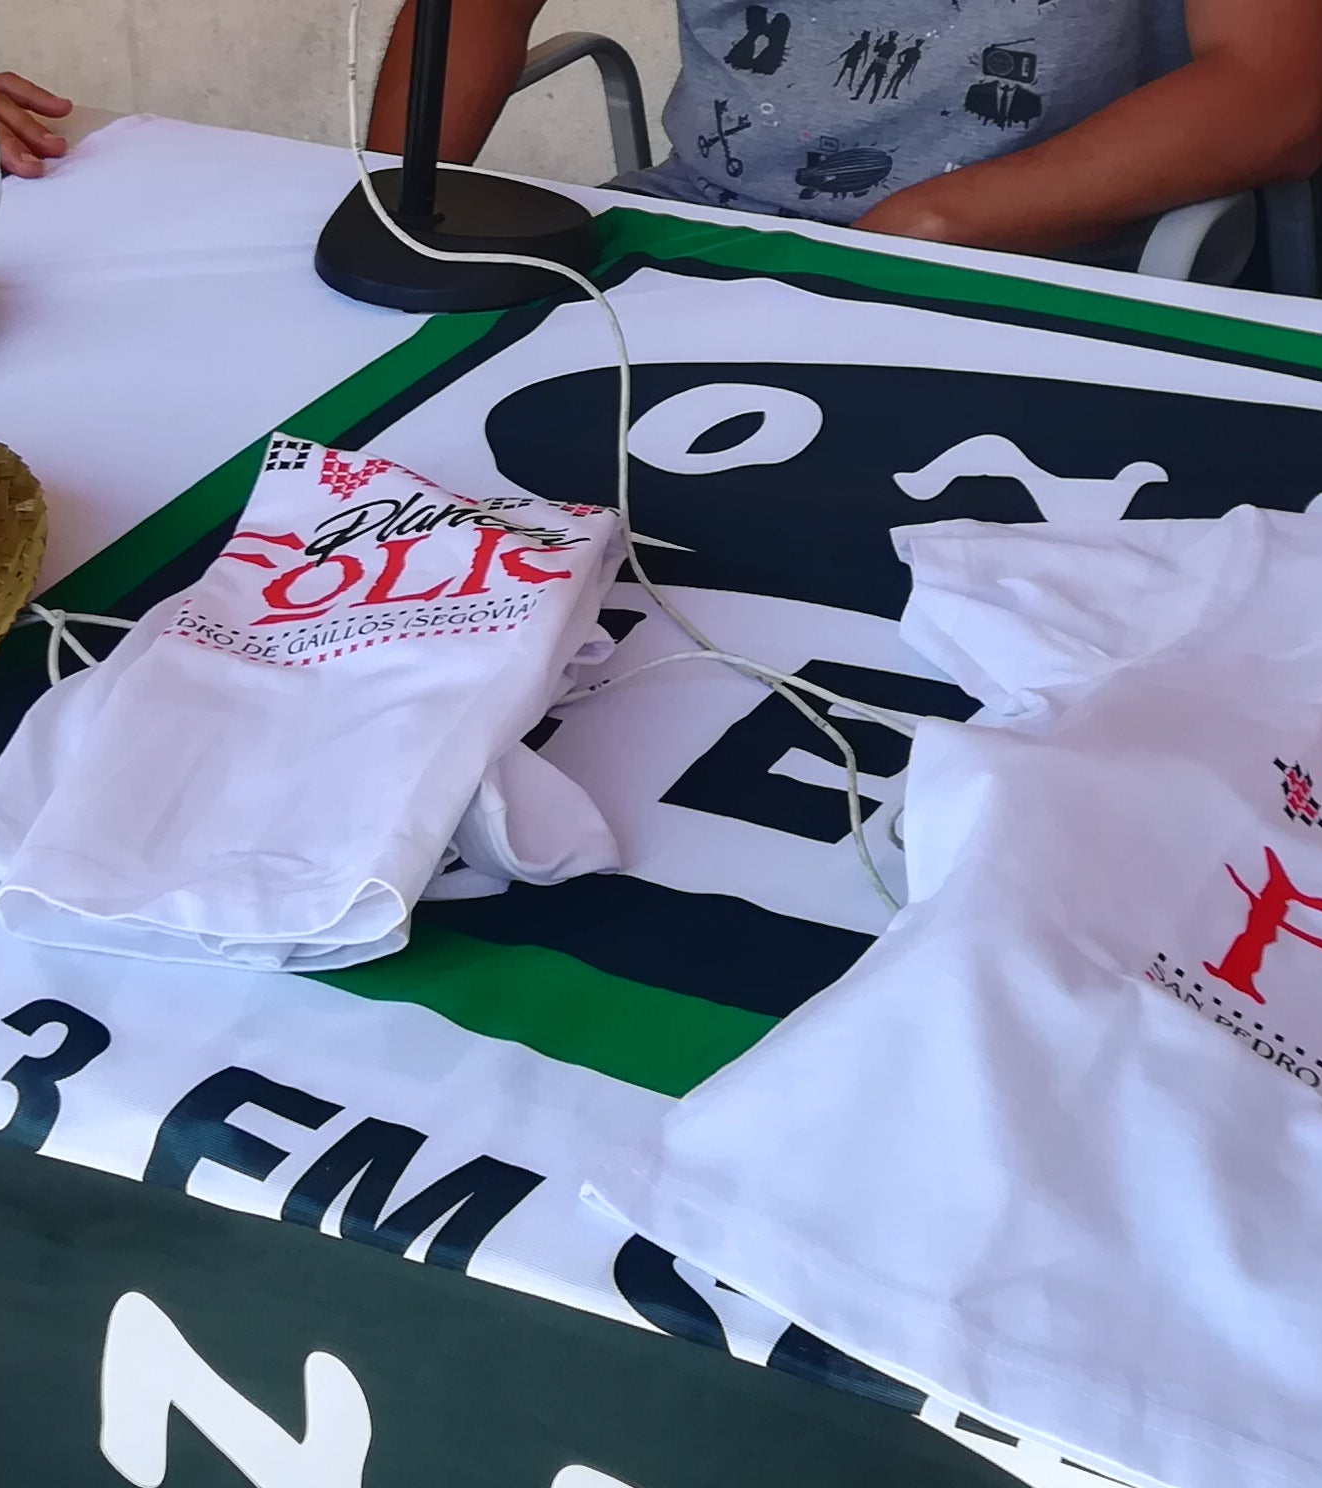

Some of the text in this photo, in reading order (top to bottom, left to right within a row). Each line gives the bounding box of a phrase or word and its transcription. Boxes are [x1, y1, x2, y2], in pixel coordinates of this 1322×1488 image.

[176, 598, 539, 659] DRO DE GAILLOS (SEGOVIA)
[1149, 961, 1205, 1012] SAN
[1213, 1013, 1322, 1089] PEDRO
[145, 1065, 549, 1278] FM
